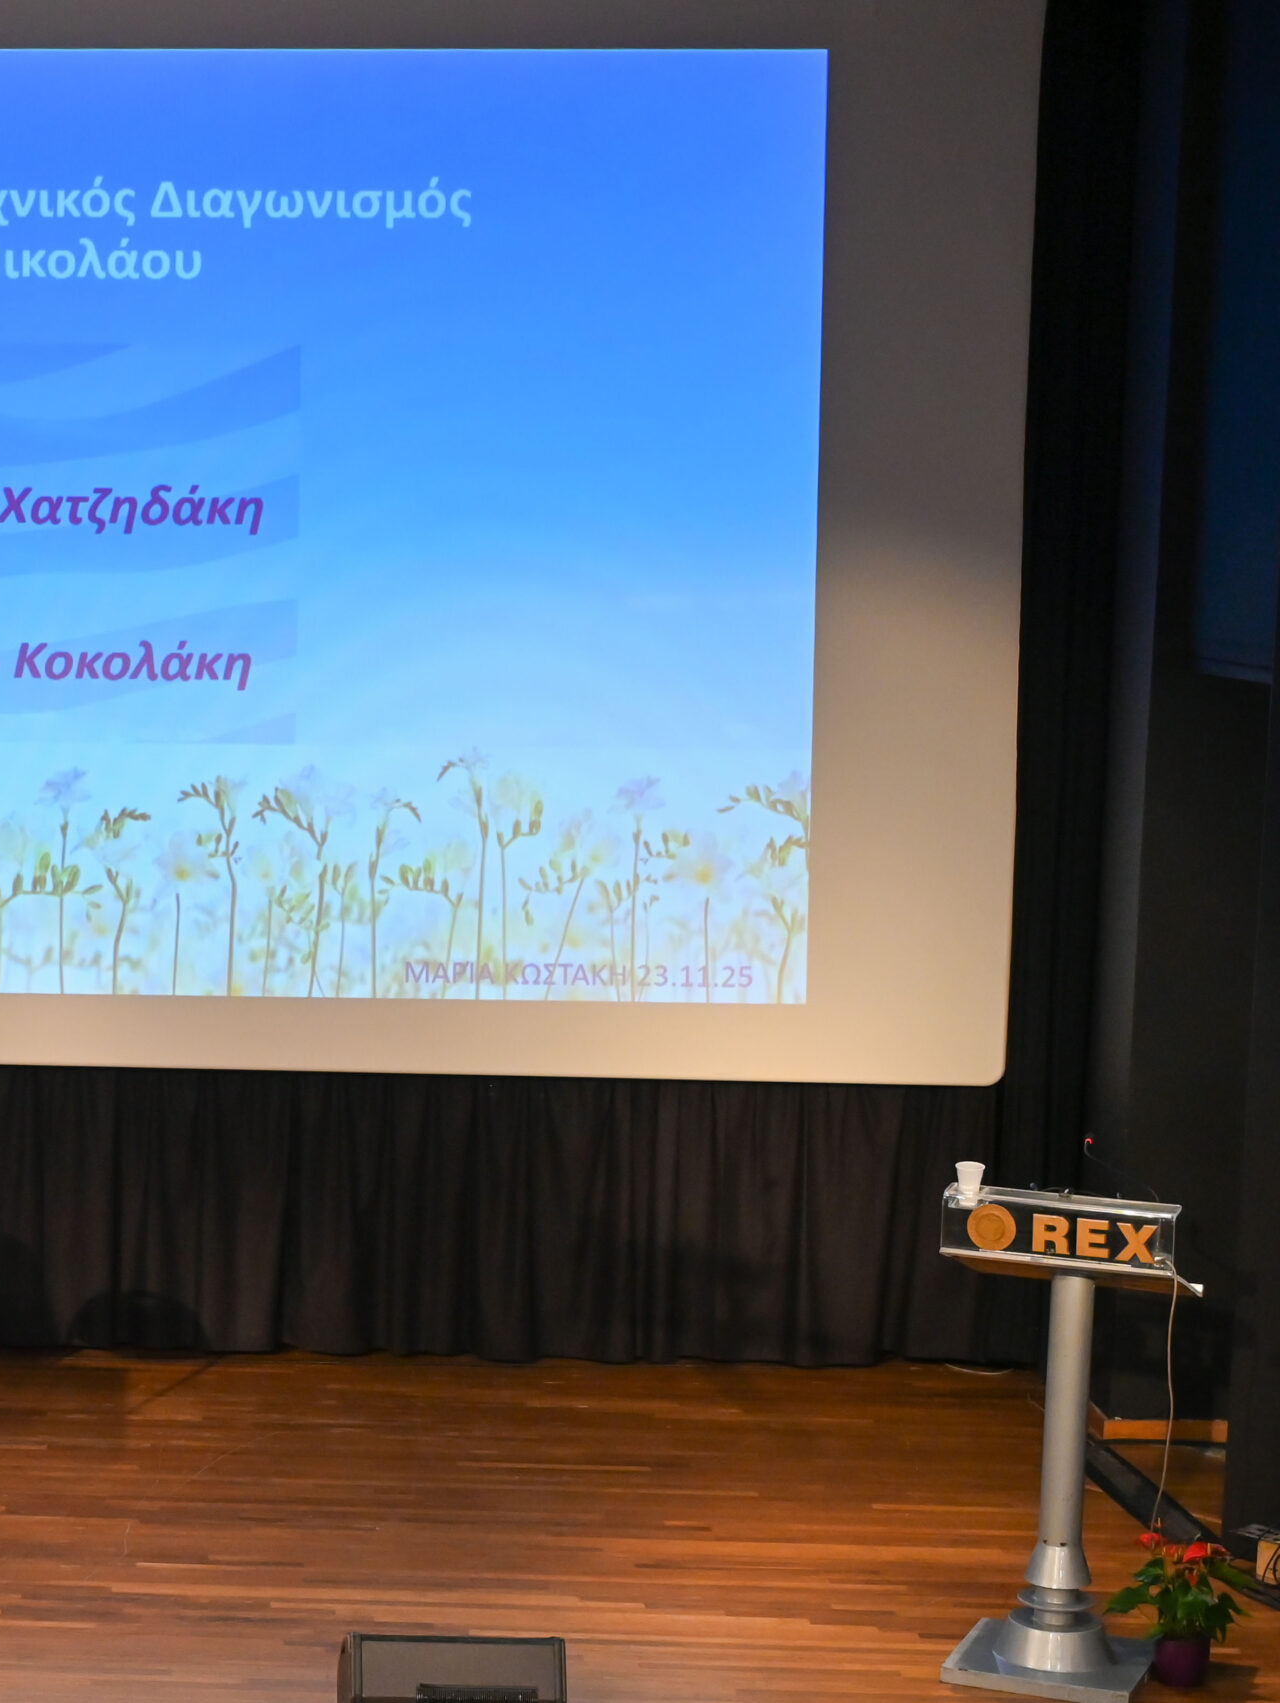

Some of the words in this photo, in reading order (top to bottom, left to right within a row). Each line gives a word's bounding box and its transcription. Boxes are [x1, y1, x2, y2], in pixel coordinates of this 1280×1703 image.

[150, 177, 472, 228] Διαγωνισμός
[14, 640, 252, 691] Κοκολάκη
[504, 962, 627, 987] ΚΩΣΤΑΚΗ
[637, 965, 753, 988] 23.11.25
[1032, 1213, 1158, 1264] REX
